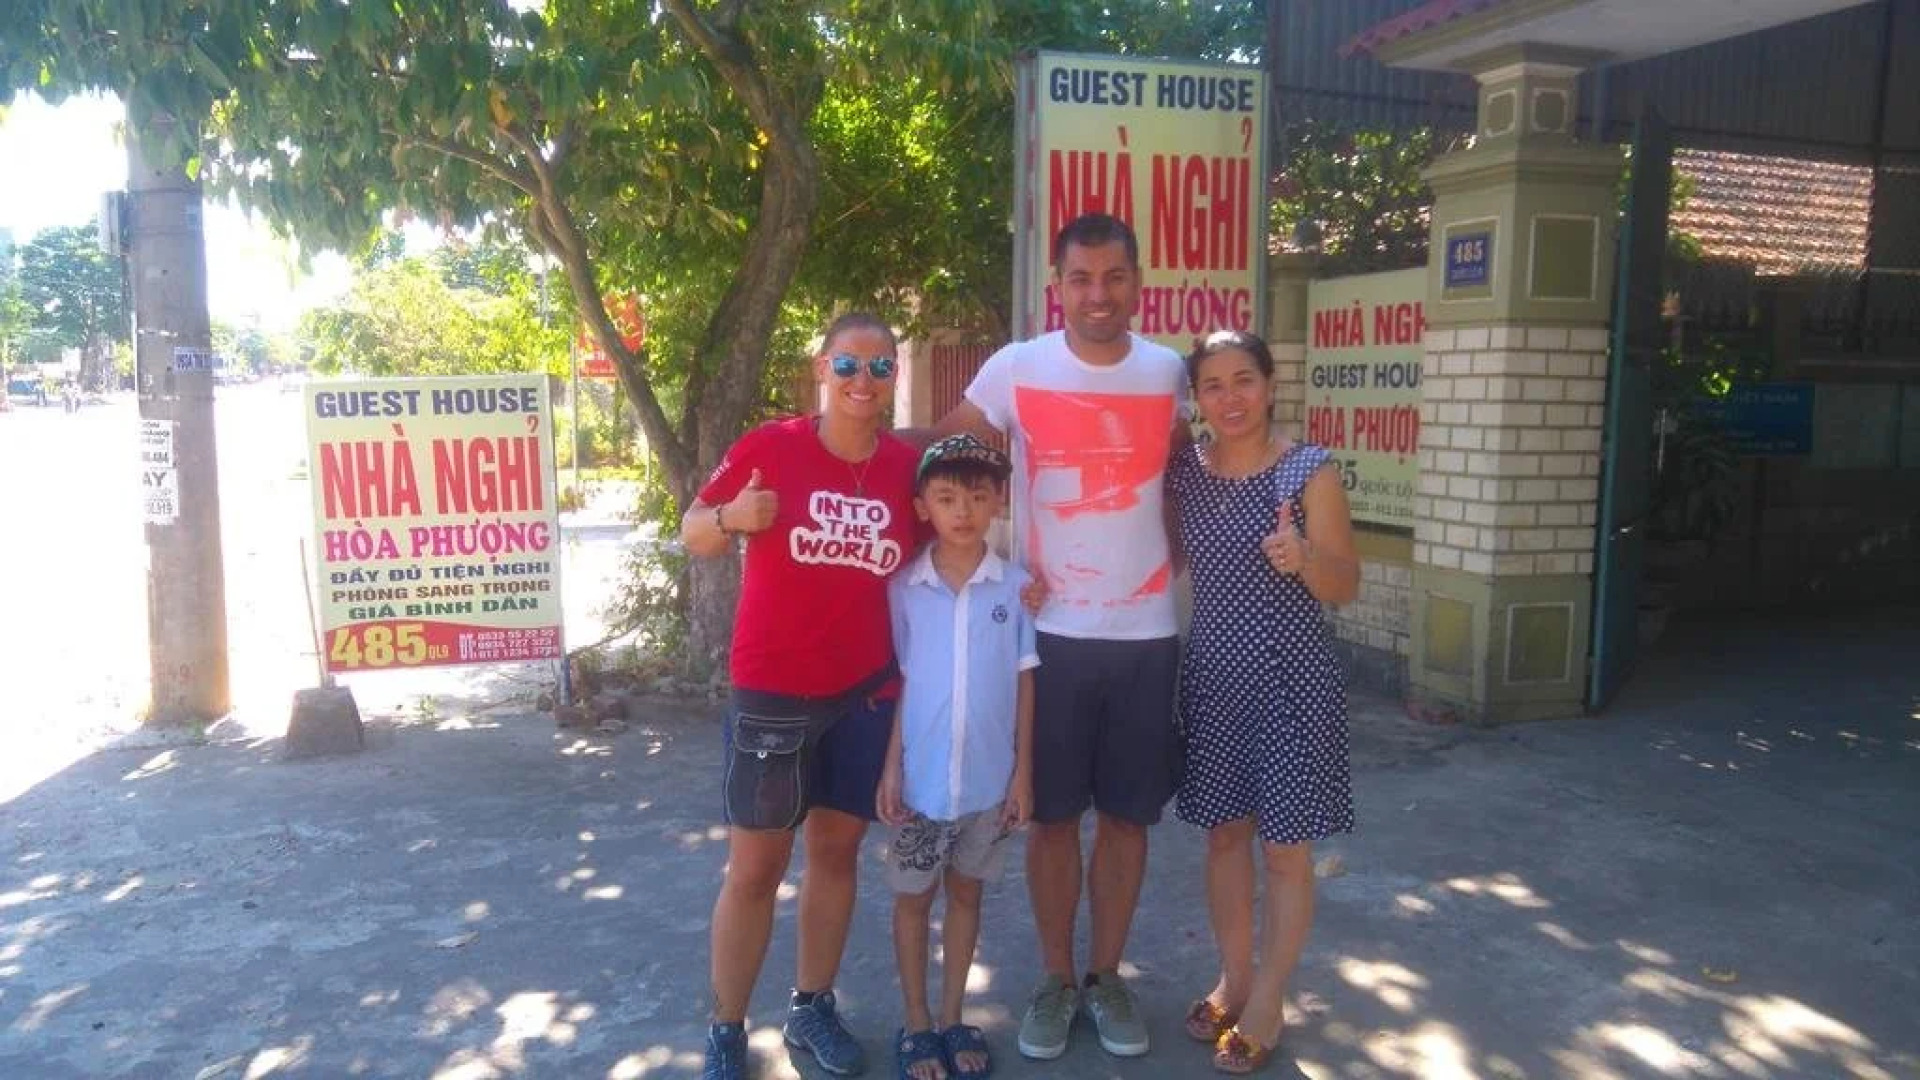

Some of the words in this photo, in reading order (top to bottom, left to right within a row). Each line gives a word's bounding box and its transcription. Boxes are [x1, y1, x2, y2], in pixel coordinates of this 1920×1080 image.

[1050, 67, 1147, 106] GUEST
[1157, 74, 1255, 112] HOUSE
[1151, 117, 1253, 270] NGHỈ
[1453, 240, 1483, 264] 485
[1314, 300, 1365, 348] NHÀ
[1311, 365, 1367, 389] GUEST
[315, 389, 421, 418] GUEST
[432, 387, 539, 415] HOUSE
[319, 423, 423, 519] NHÀ
[432, 415, 543, 515] NGHỈ
[816, 495, 885, 523] INTO
[324, 520, 400, 562] HÒA
[409, 518, 551, 563] PHƯỢNG
[826, 518, 872, 540] THE
[796, 534, 898, 570] WORLD
[429, 563, 485, 580] TIỆN
[493, 562, 551, 576] NGHI
[331, 585, 408, 602] PHÒNG
[416, 584, 474, 599] SANG
[481, 579, 551, 595] TRỌNG
[406, 601, 472, 616] BÌNH
[331, 623, 427, 668] 485
